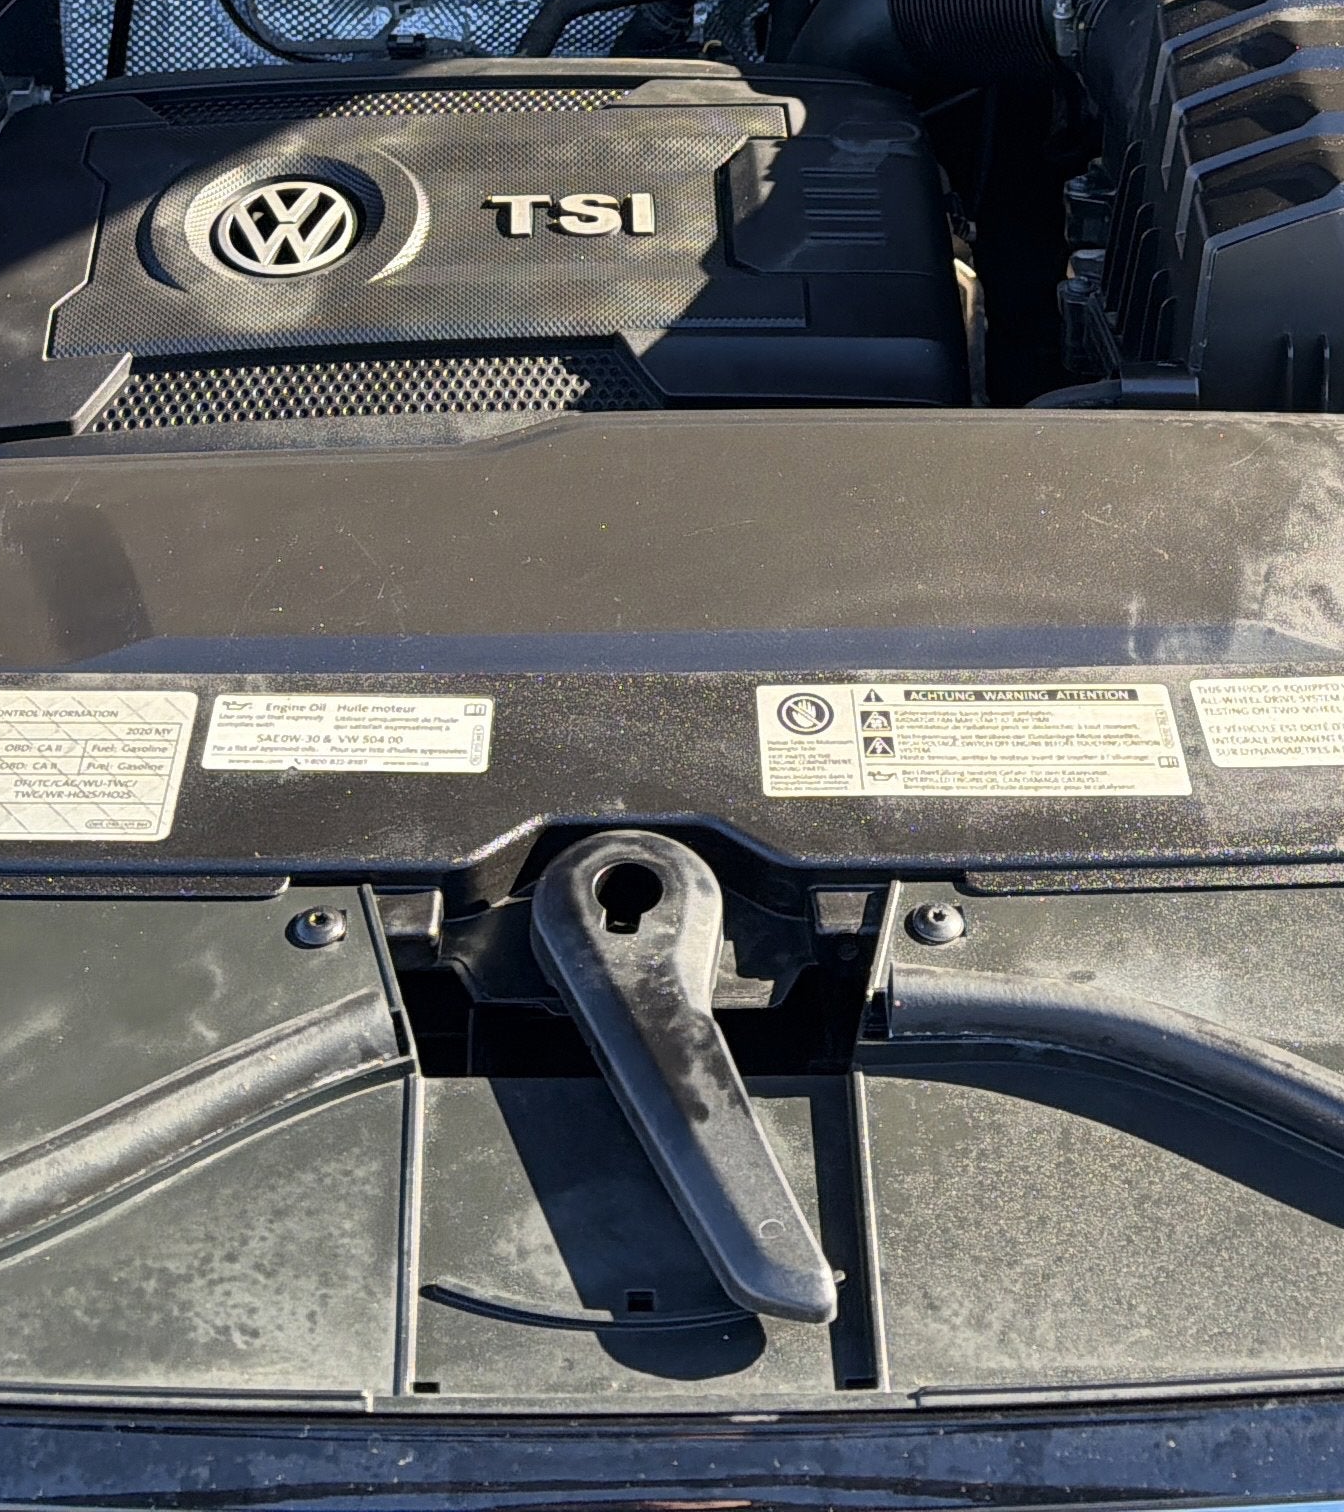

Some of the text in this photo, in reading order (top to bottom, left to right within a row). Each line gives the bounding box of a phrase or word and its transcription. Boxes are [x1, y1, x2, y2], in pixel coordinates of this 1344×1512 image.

[491, 191, 655, 237] TSI
[910, 690, 1130, 701] ACHTUNG WARNING ATTENTION
[265, 703, 327, 713] Engine Oil
[337, 704, 416, 713] Huile moteur
[42, 709, 119, 718] INFORMATION
[126, 727, 152, 736] 2020
[338, 735, 360, 744] VW
[362, 735, 385, 744] 504
[388, 735, 404, 744] 00
[37, 744, 53, 752] CA
[121, 745, 168, 753] Gasoline
[33, 762, 49, 770] CA
[117, 762, 164, 771] Gasoline
